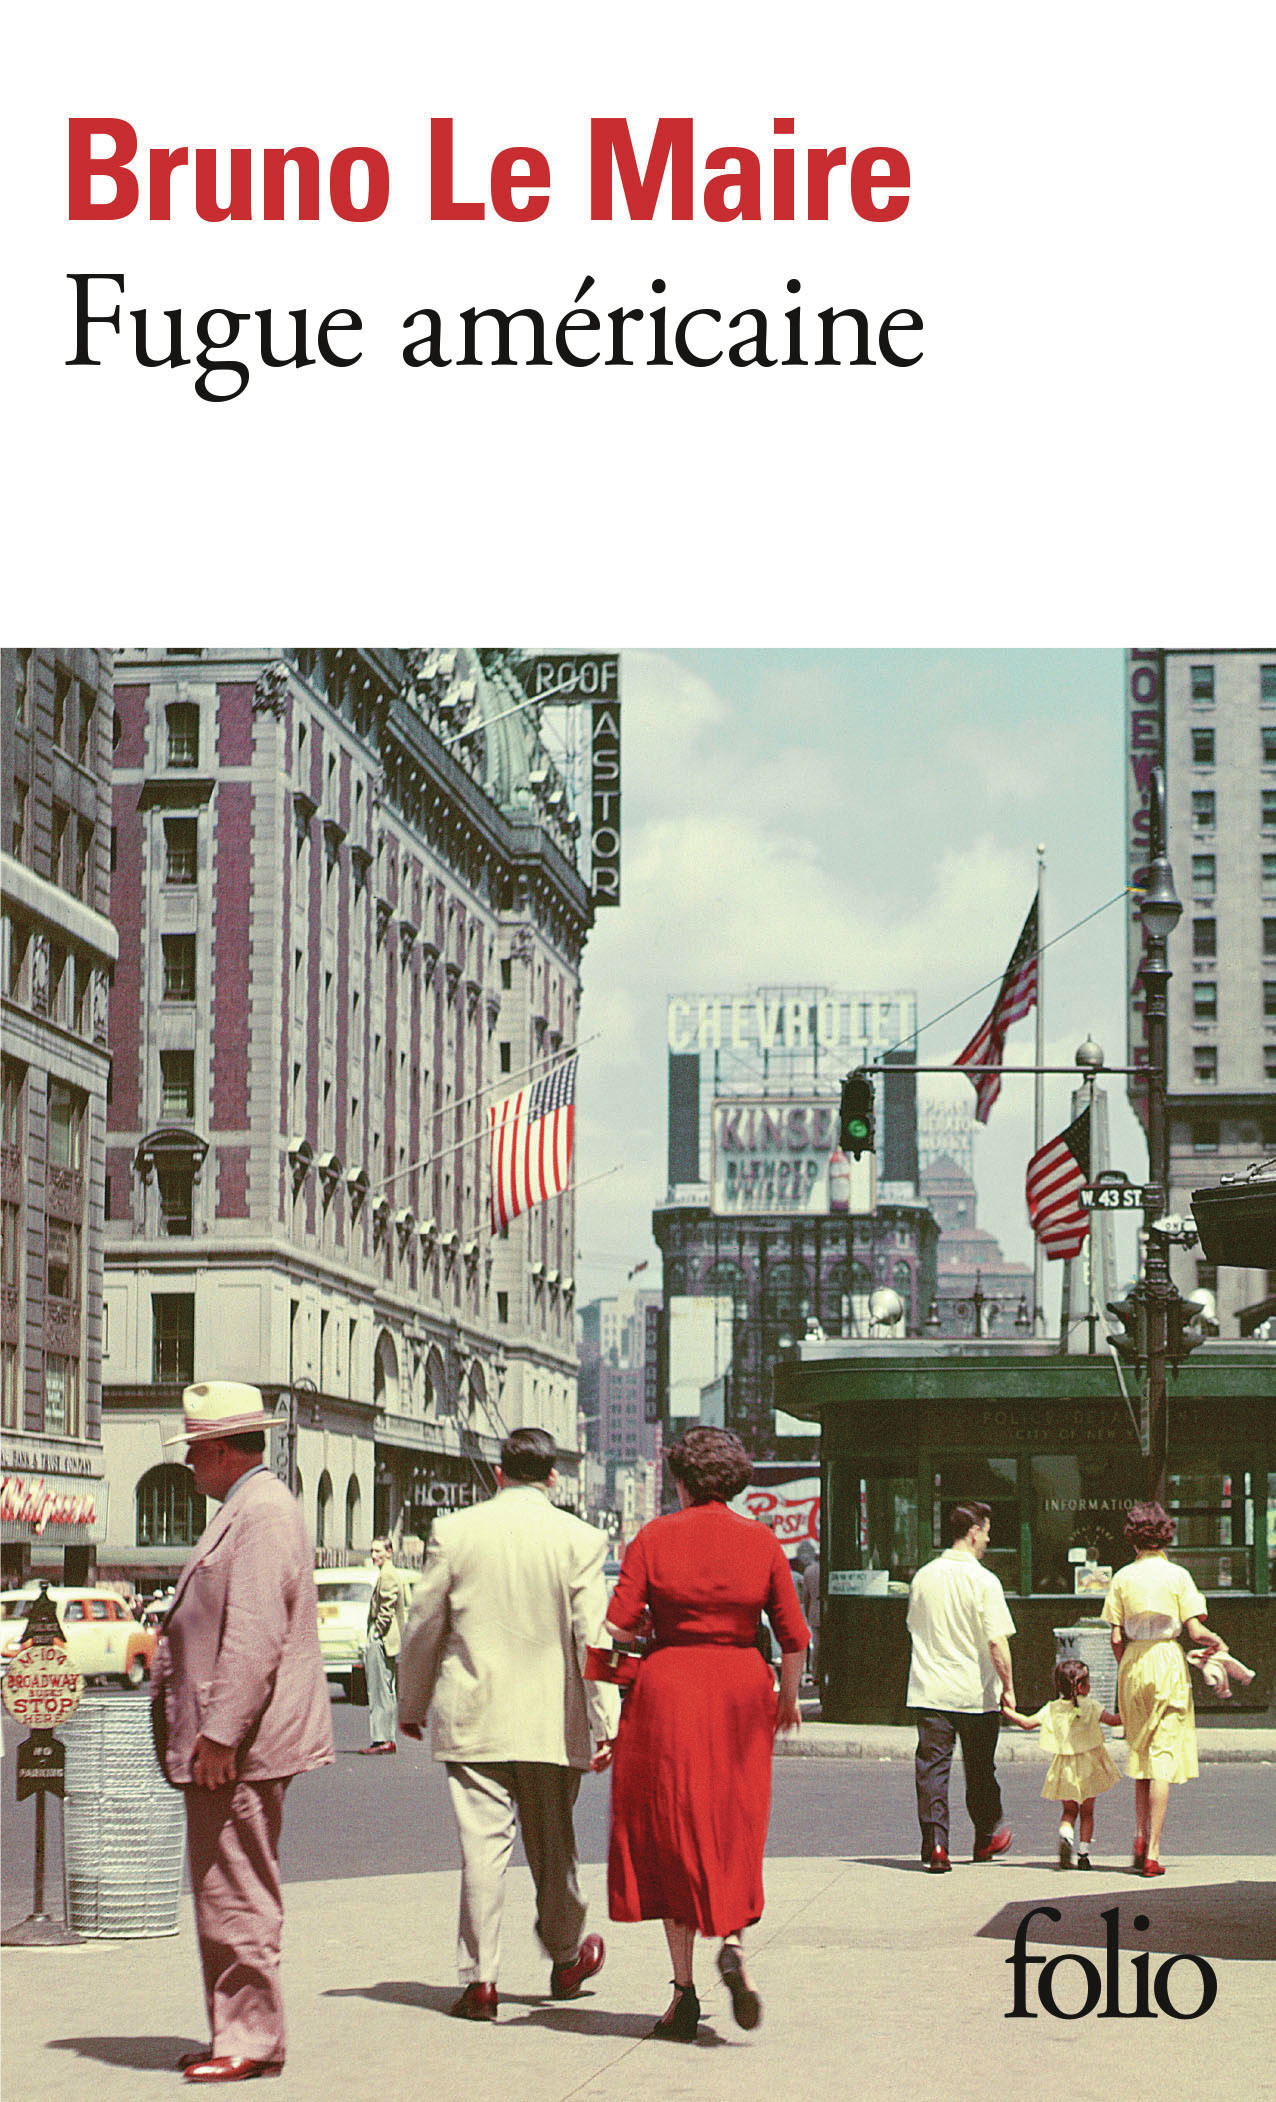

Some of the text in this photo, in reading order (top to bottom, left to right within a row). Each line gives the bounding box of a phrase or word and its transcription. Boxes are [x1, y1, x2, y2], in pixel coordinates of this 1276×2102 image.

[536, 660, 617, 694] ROOF
[591, 710, 620, 898] ASTOR
[667, 994, 916, 1051] CHEVROLET
[720, 1108, 833, 1152] KINSE
[1081, 1189, 1144, 1207] W. 43 ST.
[414, 1481, 486, 1507] HOTEL
[19, 1648, 67, 1669] M-104
[8, 1674, 80, 1689] BROADWAY
[13, 1698, 74, 1714] STOP
[23, 1713, 65, 1724] HERE
[33, 1746, 53, 1756] NO
[19, 1768, 65, 1778] PARKING
